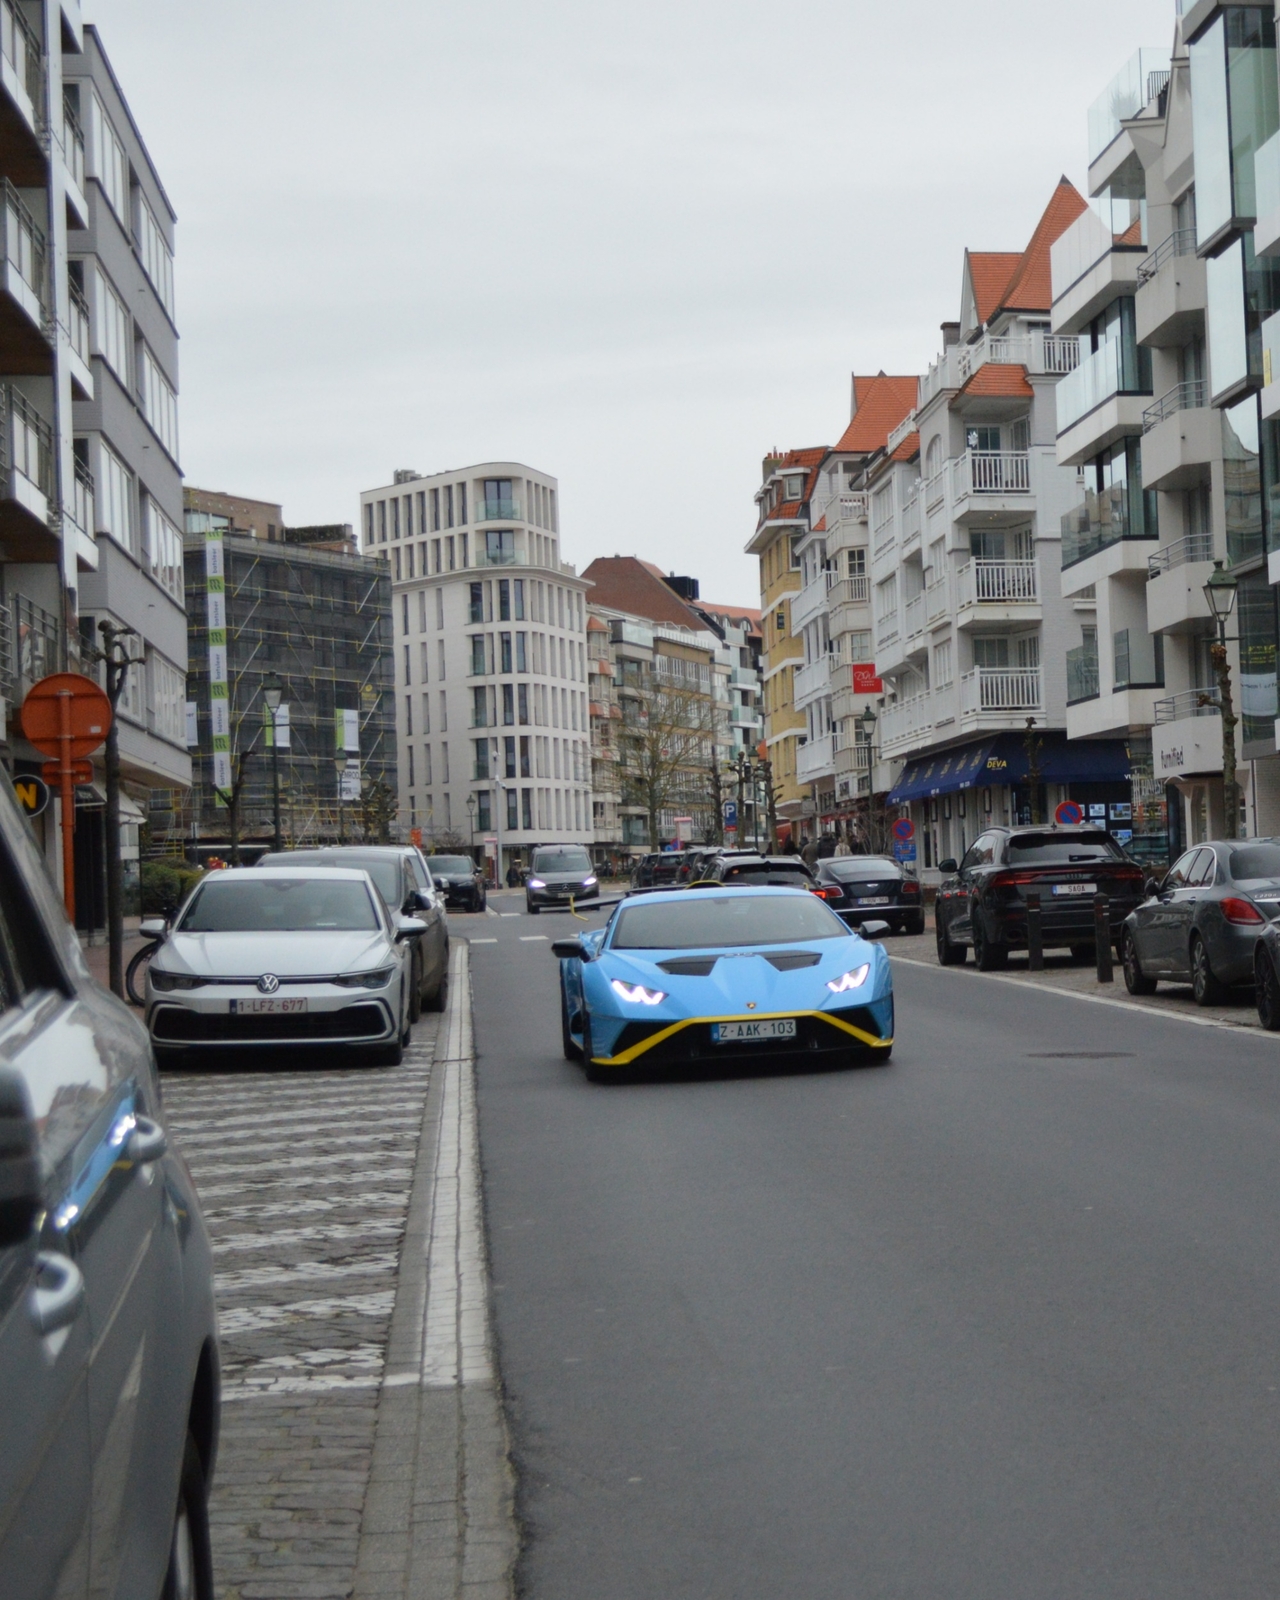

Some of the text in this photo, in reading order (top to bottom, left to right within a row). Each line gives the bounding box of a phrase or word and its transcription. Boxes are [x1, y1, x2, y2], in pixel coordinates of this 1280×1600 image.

[986, 760, 1007, 768] DEVA
[726, 805, 735, 818] P
[239, 1000, 304, 1012] 1-LFZ-677
[720, 1022, 794, 1038] Z-AAK-103
